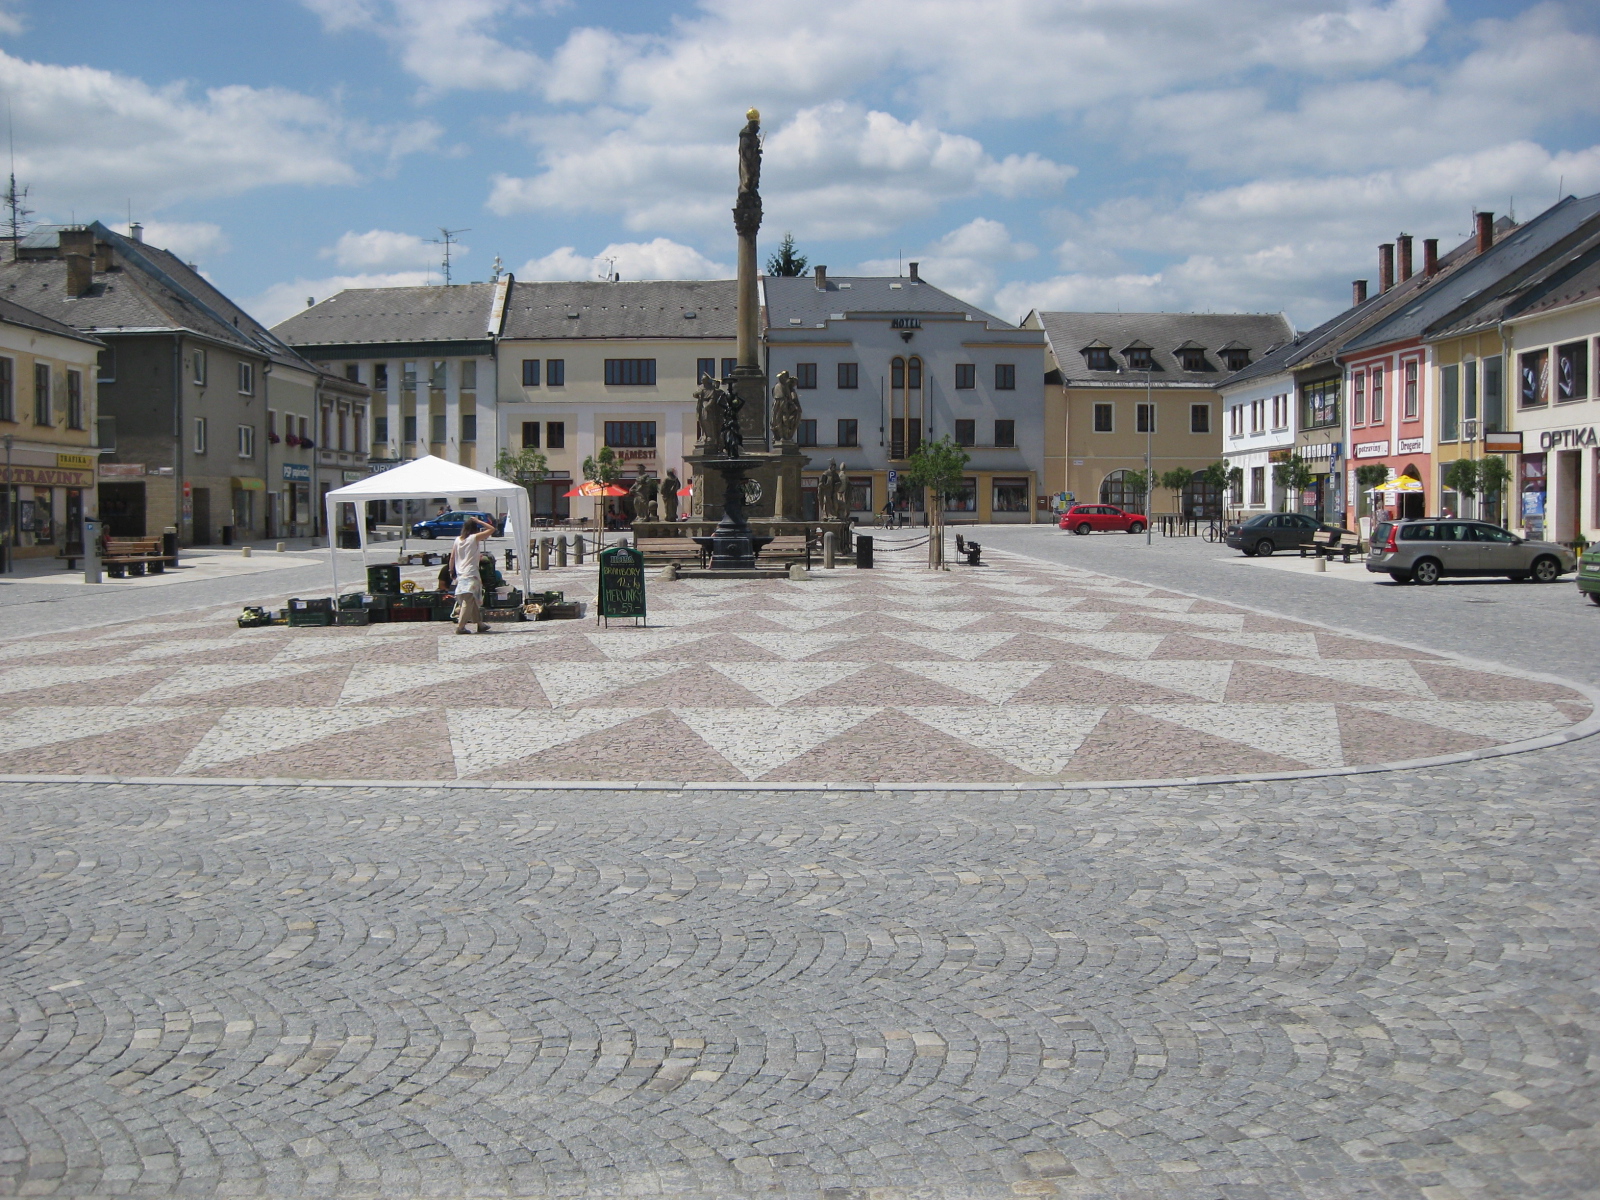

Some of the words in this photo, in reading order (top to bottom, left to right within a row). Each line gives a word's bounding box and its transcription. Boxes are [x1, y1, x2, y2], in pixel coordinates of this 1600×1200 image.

[892, 319, 921, 328] HOTEL
[1540, 426, 1597, 448] OPTIKA
[1358, 444, 1380, 454] potraviny
[1400, 440, 1421, 452] Drogerie
[60, 454, 86, 464] TRAFIKA
[618, 450, 656, 460] NÁMĚSTÍ
[368, 464, 391, 472] TURY
[0, 468, 84, 485] OTRAVINY
